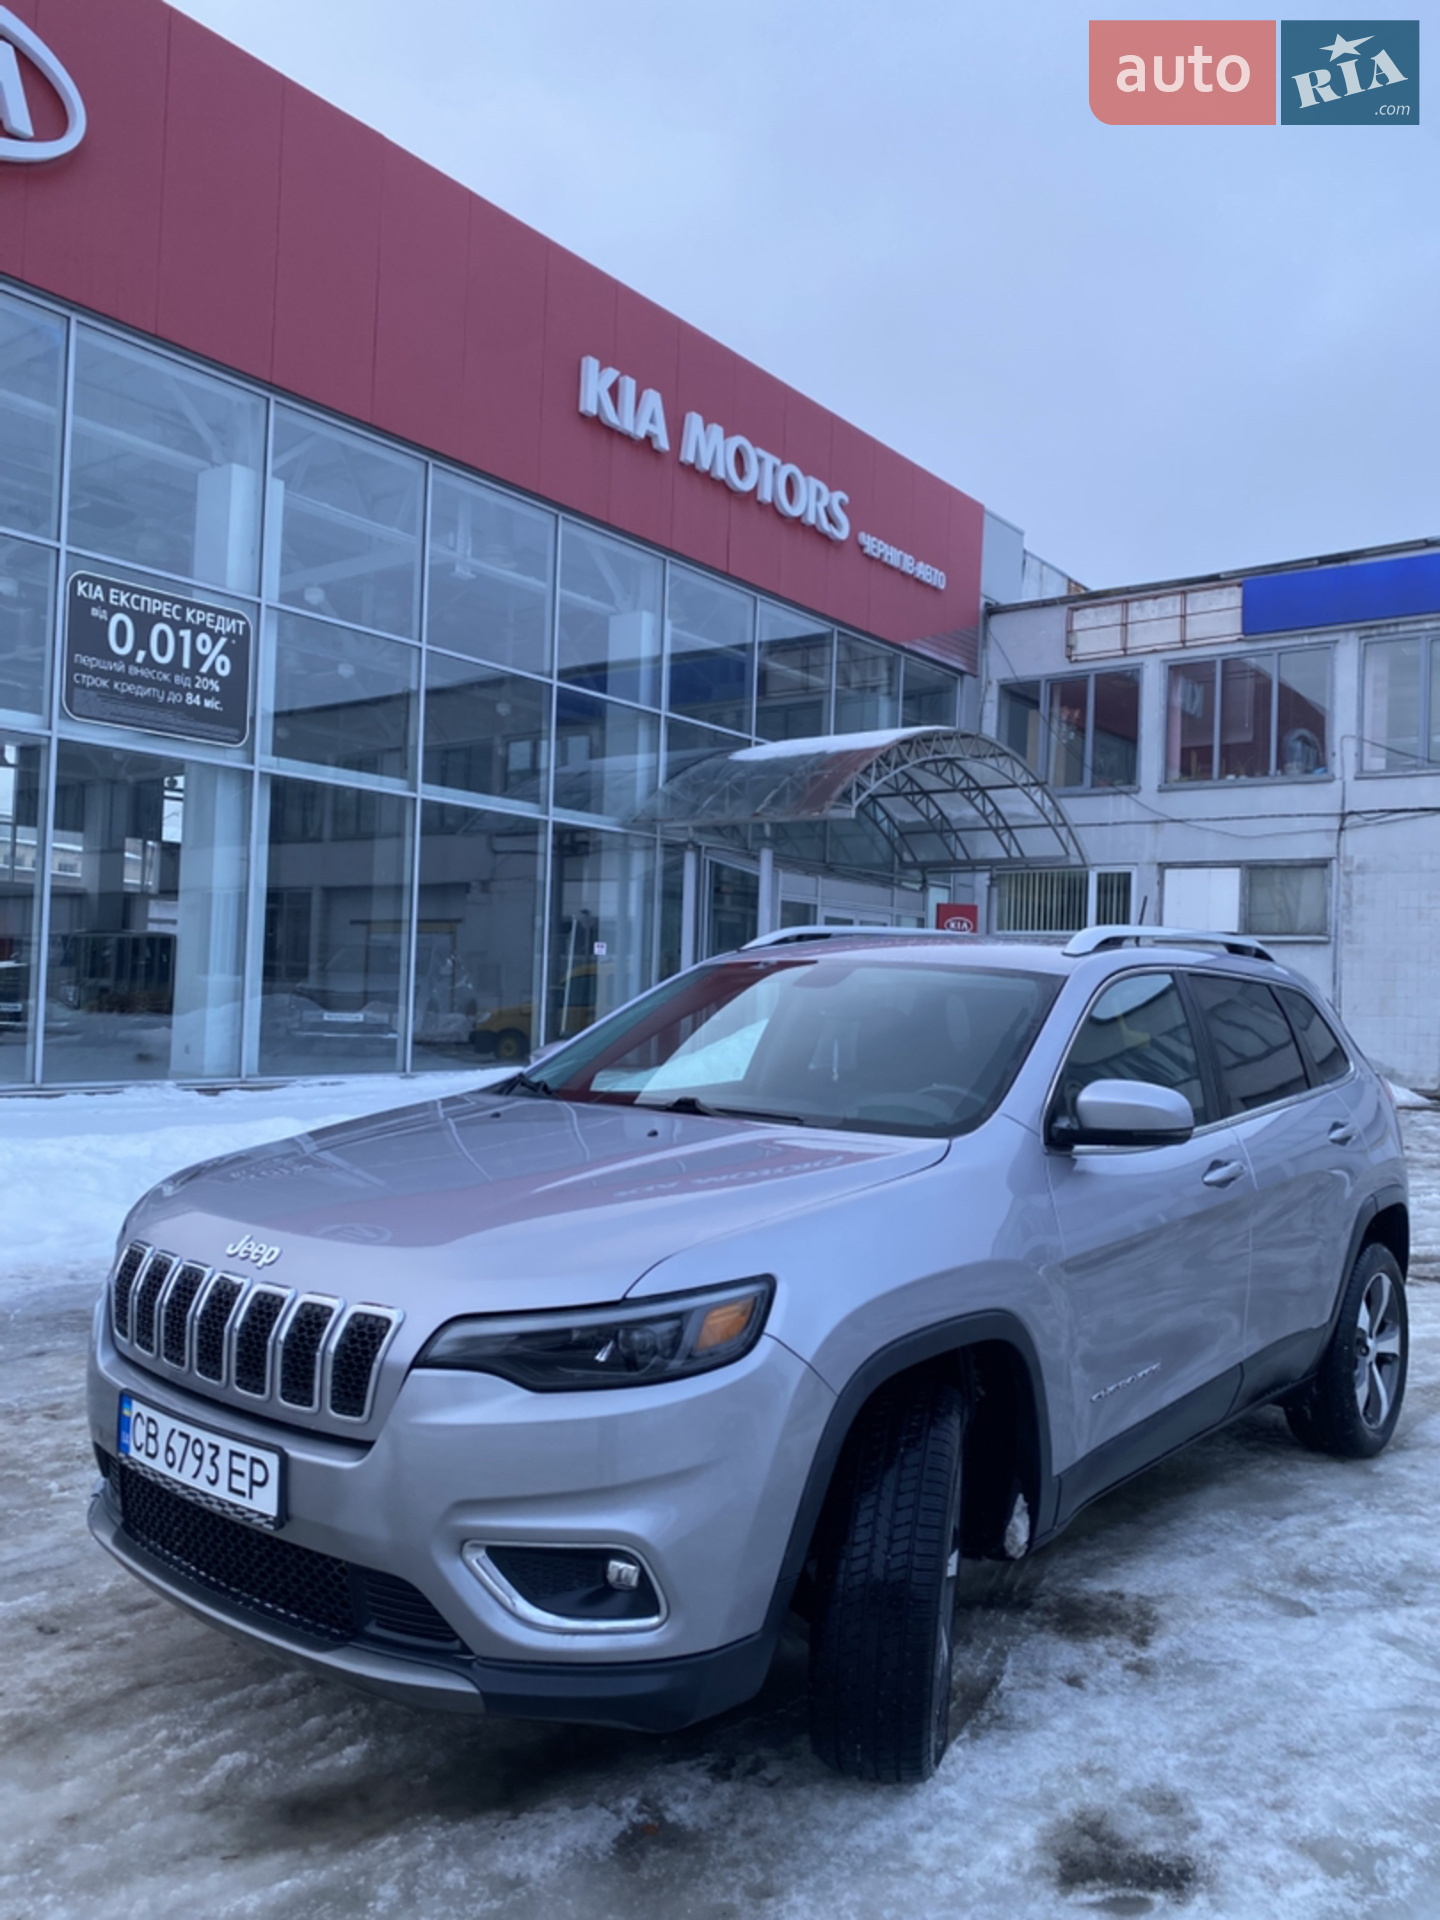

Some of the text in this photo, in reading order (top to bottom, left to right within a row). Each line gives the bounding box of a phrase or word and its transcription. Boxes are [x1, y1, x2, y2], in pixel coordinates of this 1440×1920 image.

[578, 354, 851, 542] KIA MOTORS
[76, 580, 246, 635] KIA ЕКСПРЕС КРЕДИТ
[90, 605, 108, 621] від
[73, 672, 110, 689] строк
[113, 680, 165, 703] кредиту
[167, 690, 183, 705] до
[185, 692, 201, 707] 84
[74, 653, 220, 692] перший внесок від 20%
[950, 921, 968, 931] KIA
[225, 1234, 281, 1269] Jeep
[132, 1411, 269, 1500] CB 6793 EP
